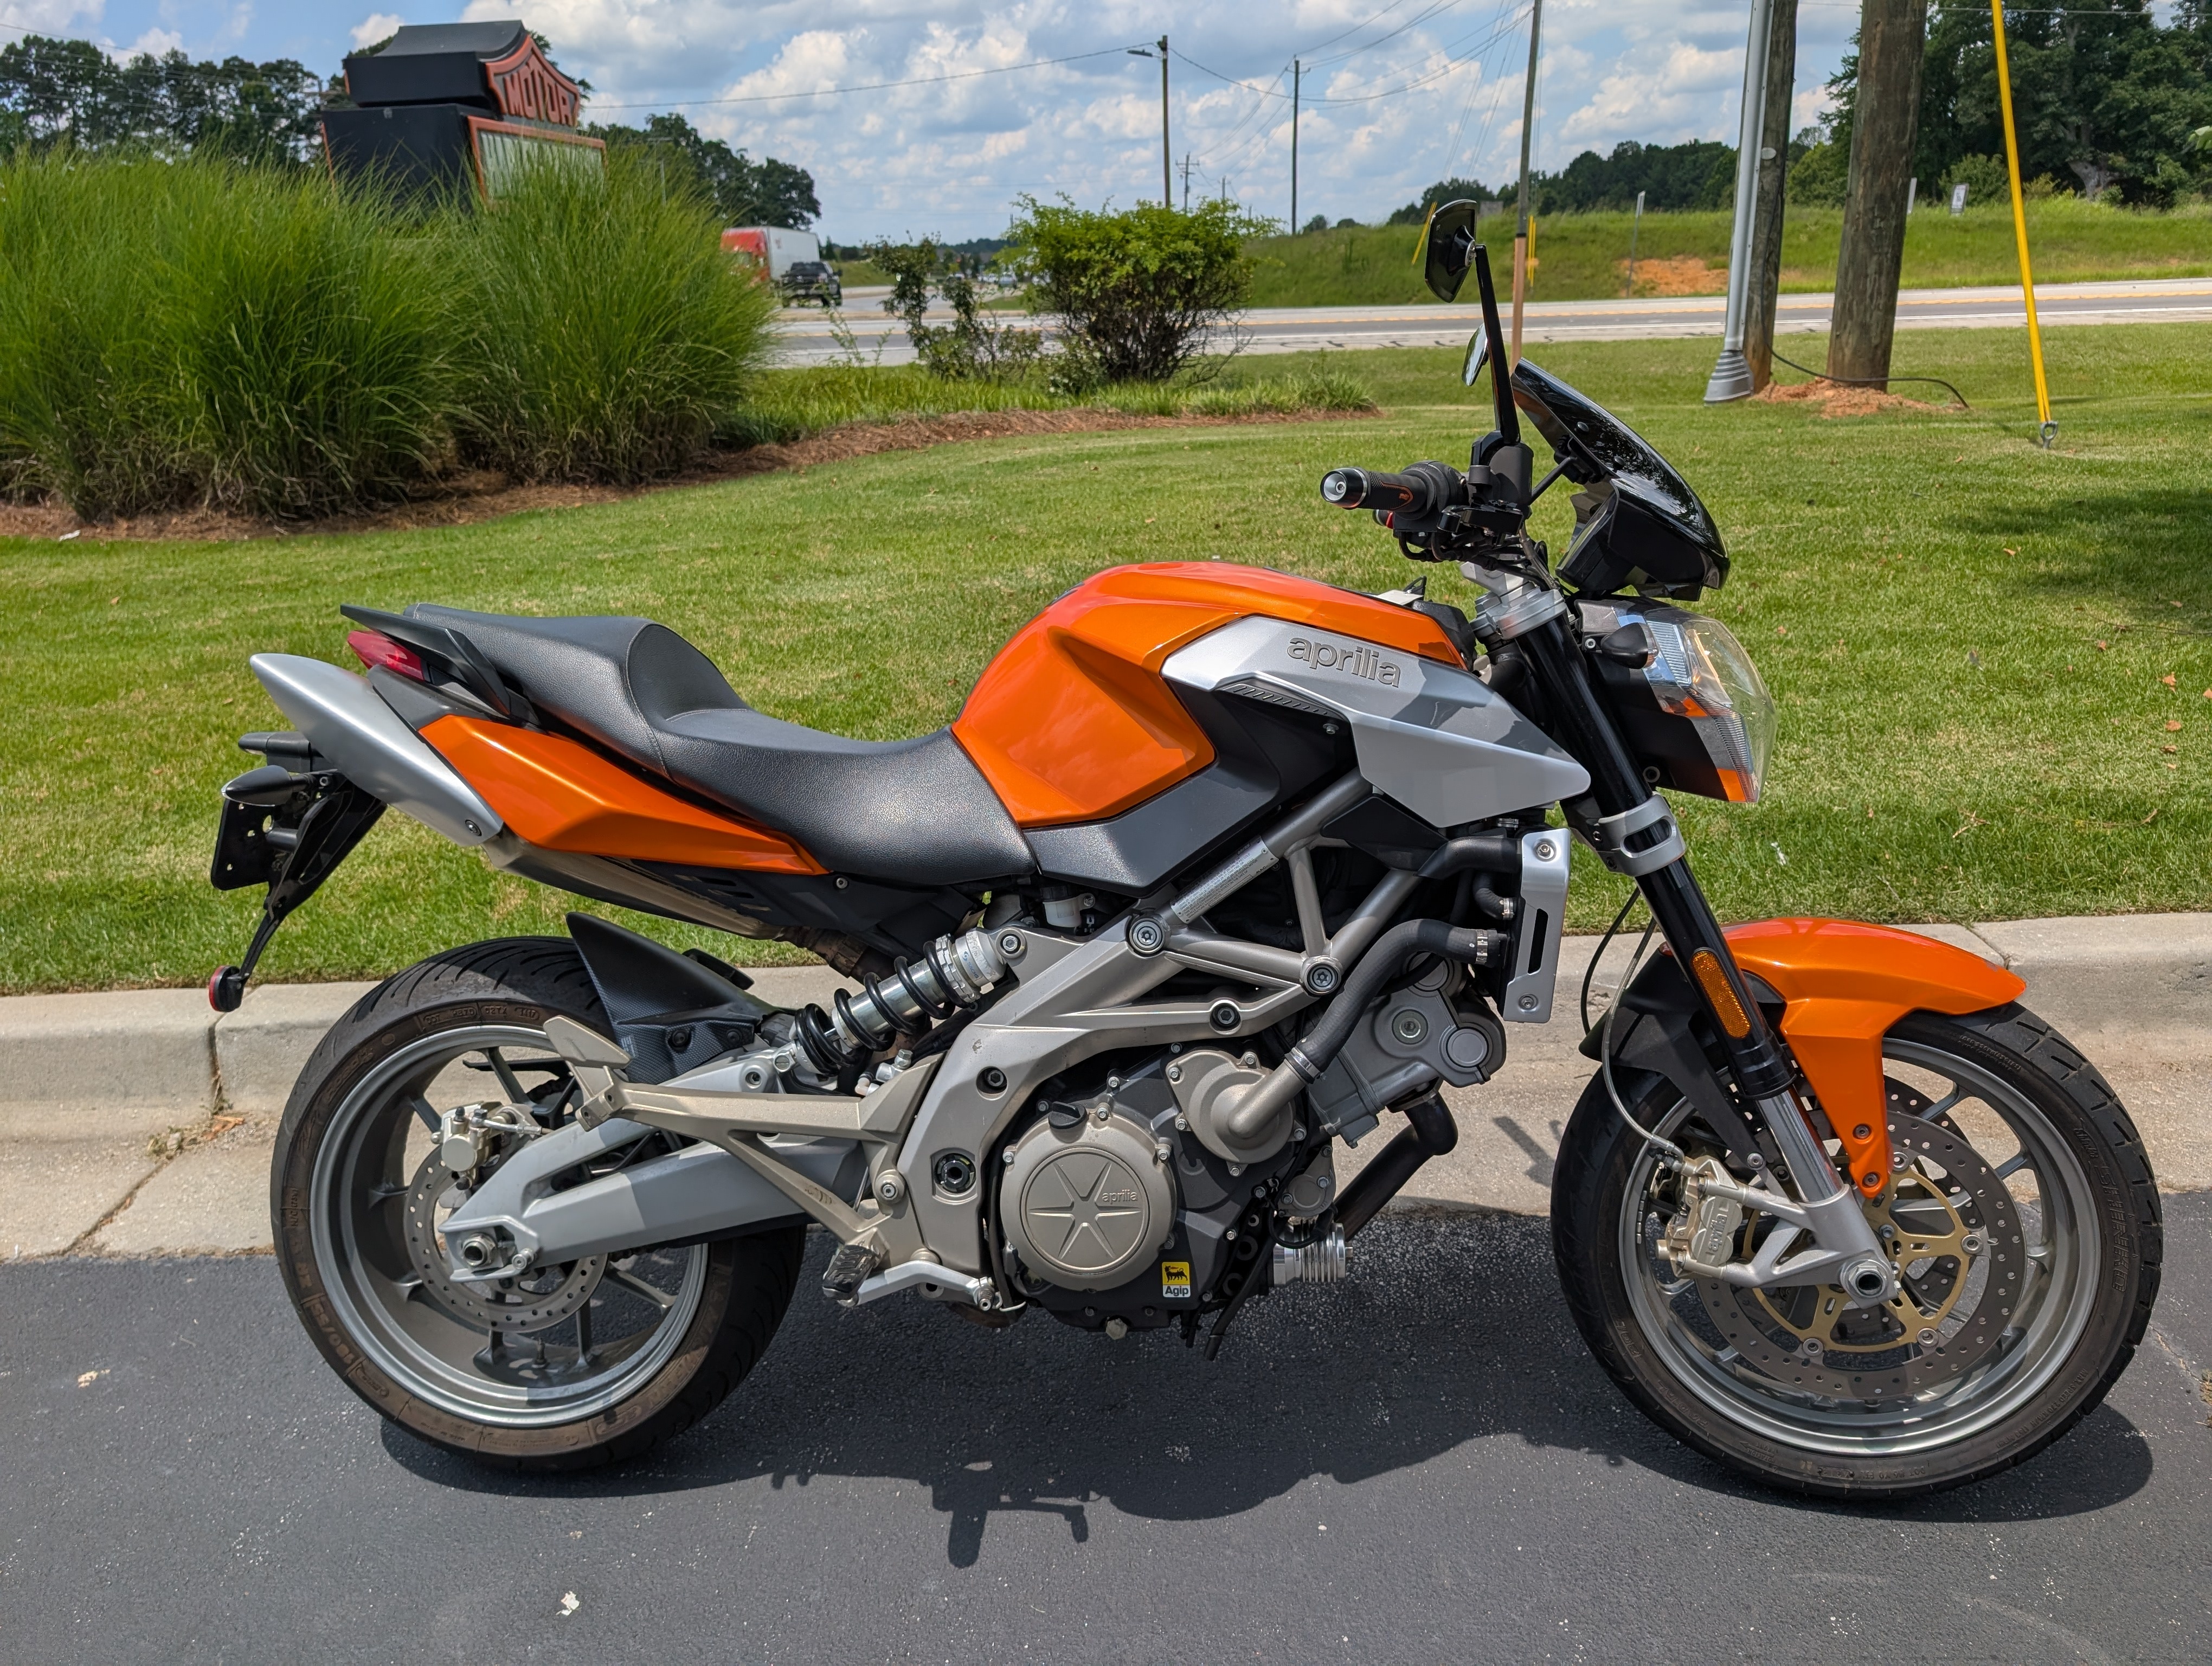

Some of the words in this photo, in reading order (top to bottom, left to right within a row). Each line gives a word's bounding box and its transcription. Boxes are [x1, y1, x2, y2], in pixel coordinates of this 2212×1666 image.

[503, 53, 575, 127] MOTOR
[1287, 637, 1400, 688] aprilia
[967, 962, 979, 979] SACHS
[1102, 1189, 1137, 1204] aprilia
[1708, 1214, 1727, 1253] aprilia
[2093, 1159, 2130, 1292] SHINKO
[1165, 1285, 1189, 1297] Agip
[1652, 1379, 1711, 1429] RADIAL
